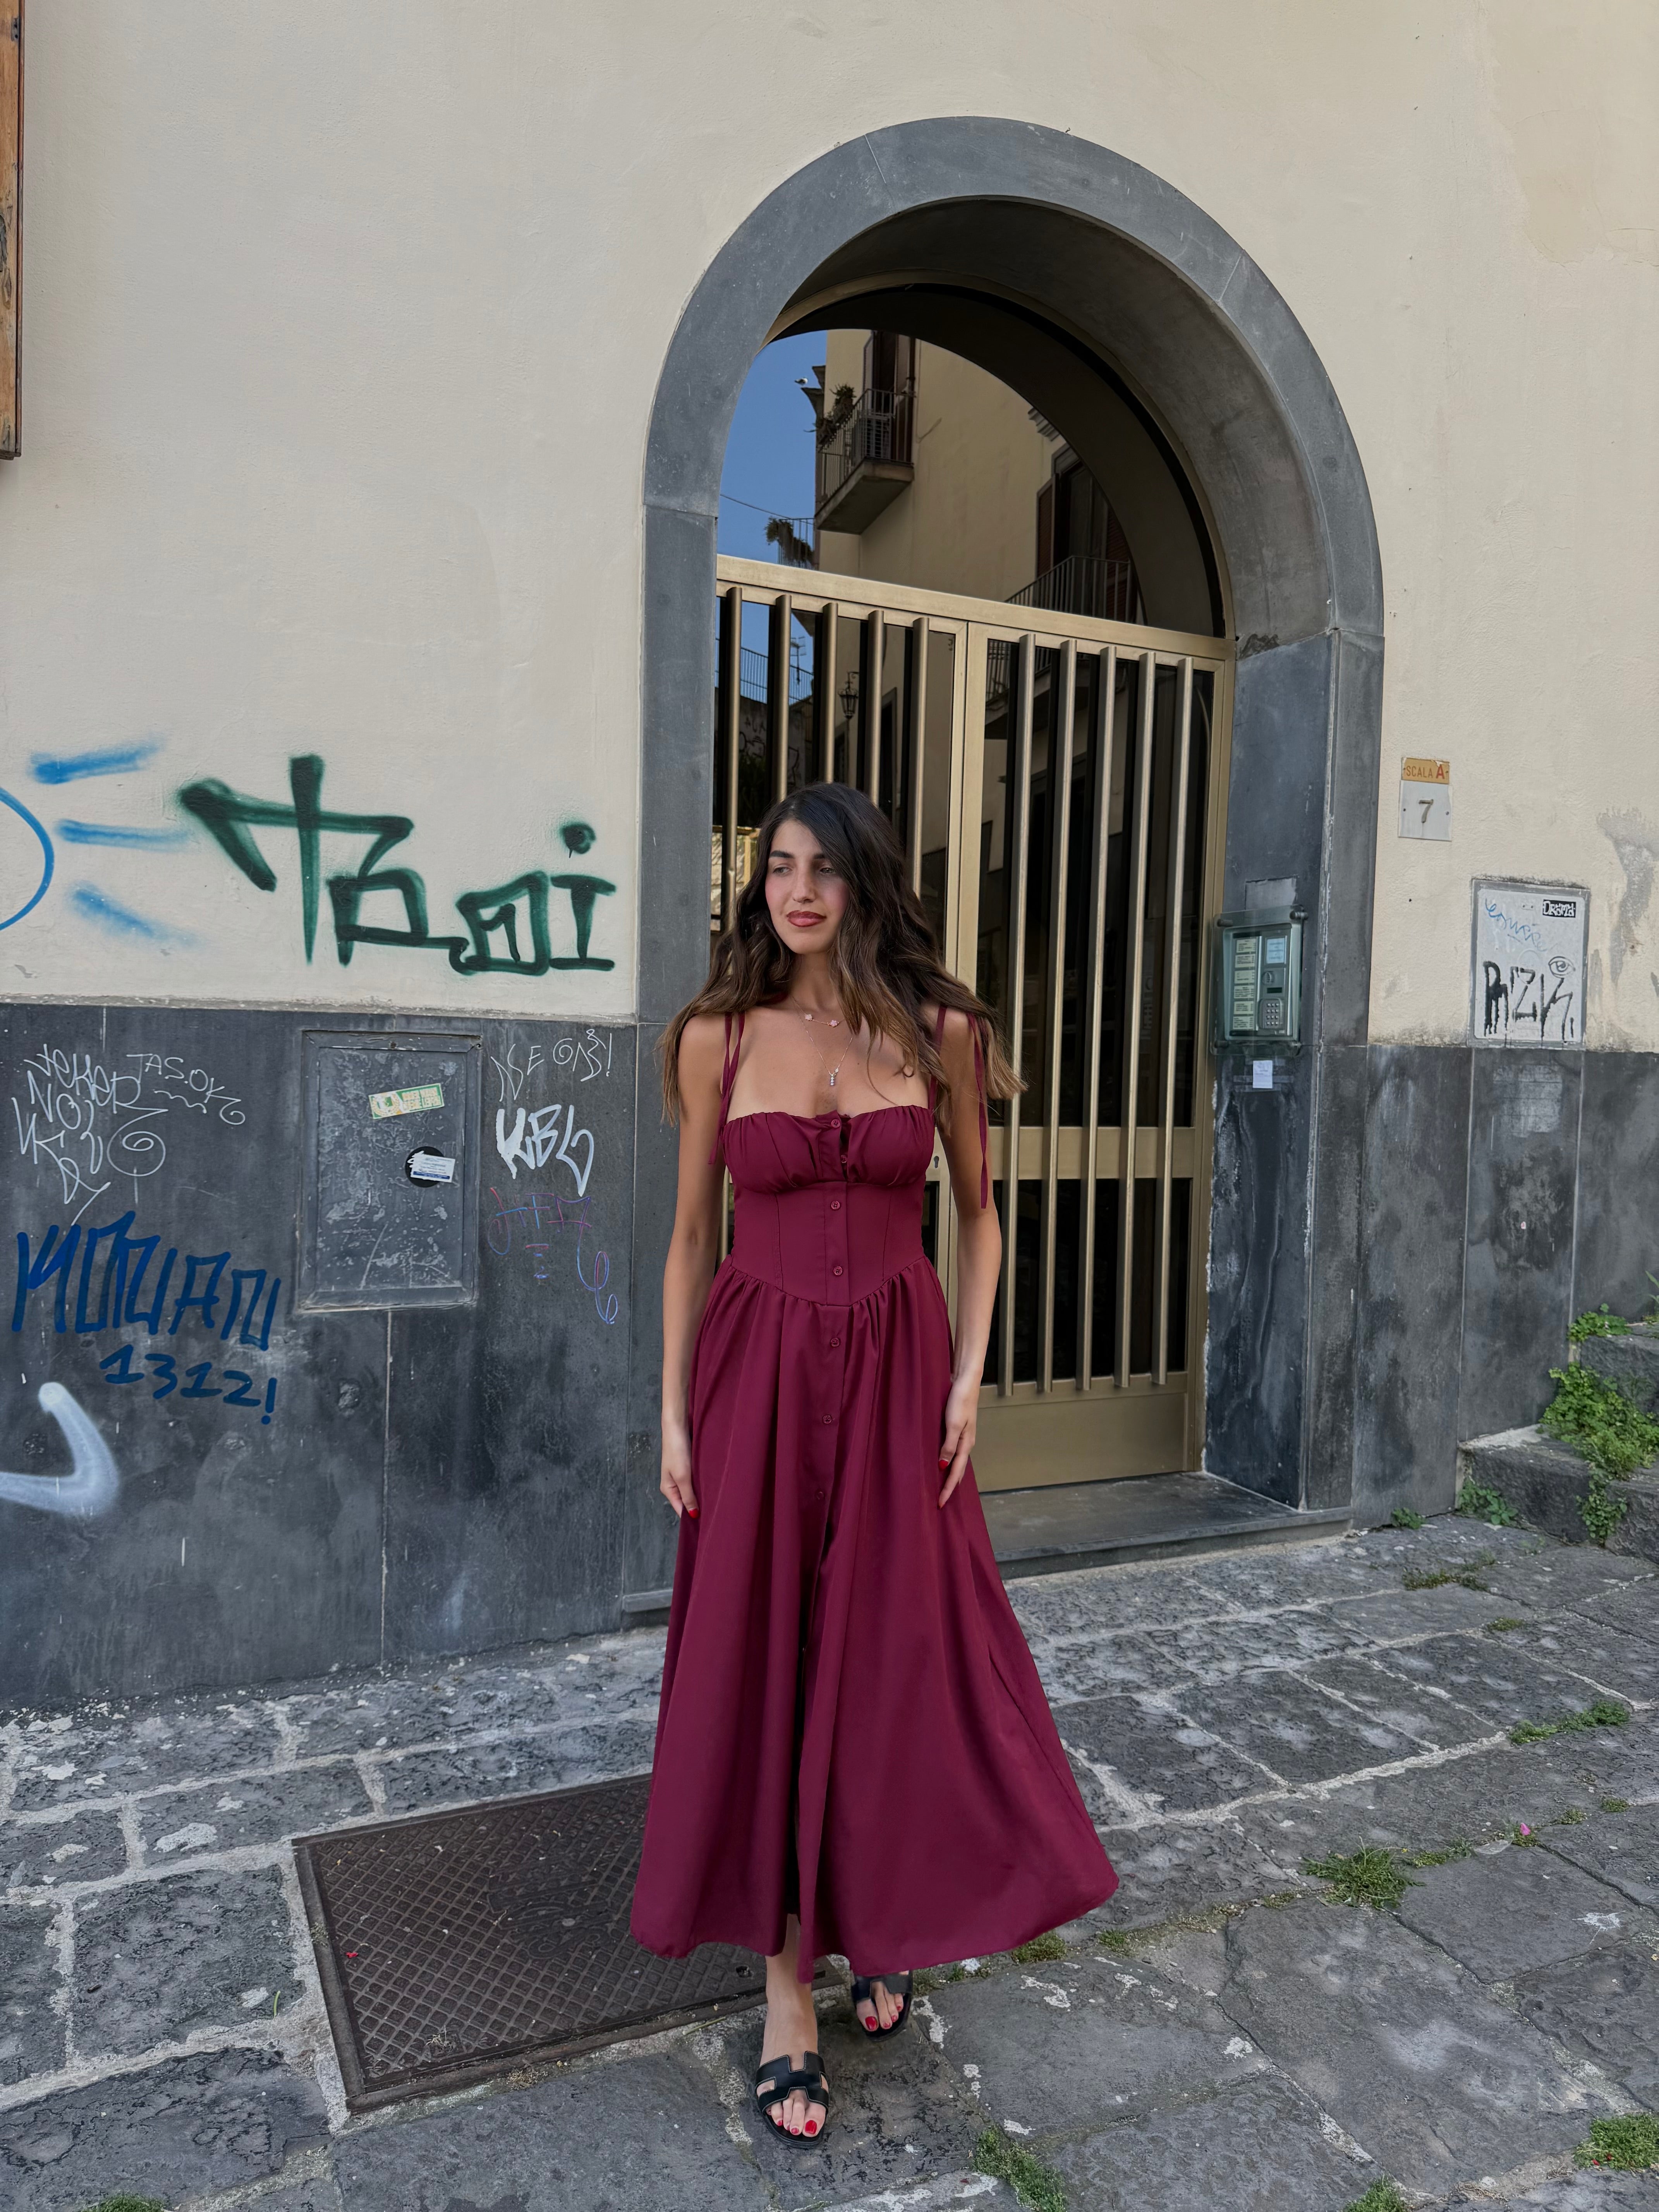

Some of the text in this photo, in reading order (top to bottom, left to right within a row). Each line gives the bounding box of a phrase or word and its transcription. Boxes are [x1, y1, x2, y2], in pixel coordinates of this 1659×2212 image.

[1406, 764, 1445, 779] SCALA A
[1419, 799, 1434, 823] 7
[100, 1344, 278, 1425] 1312!
